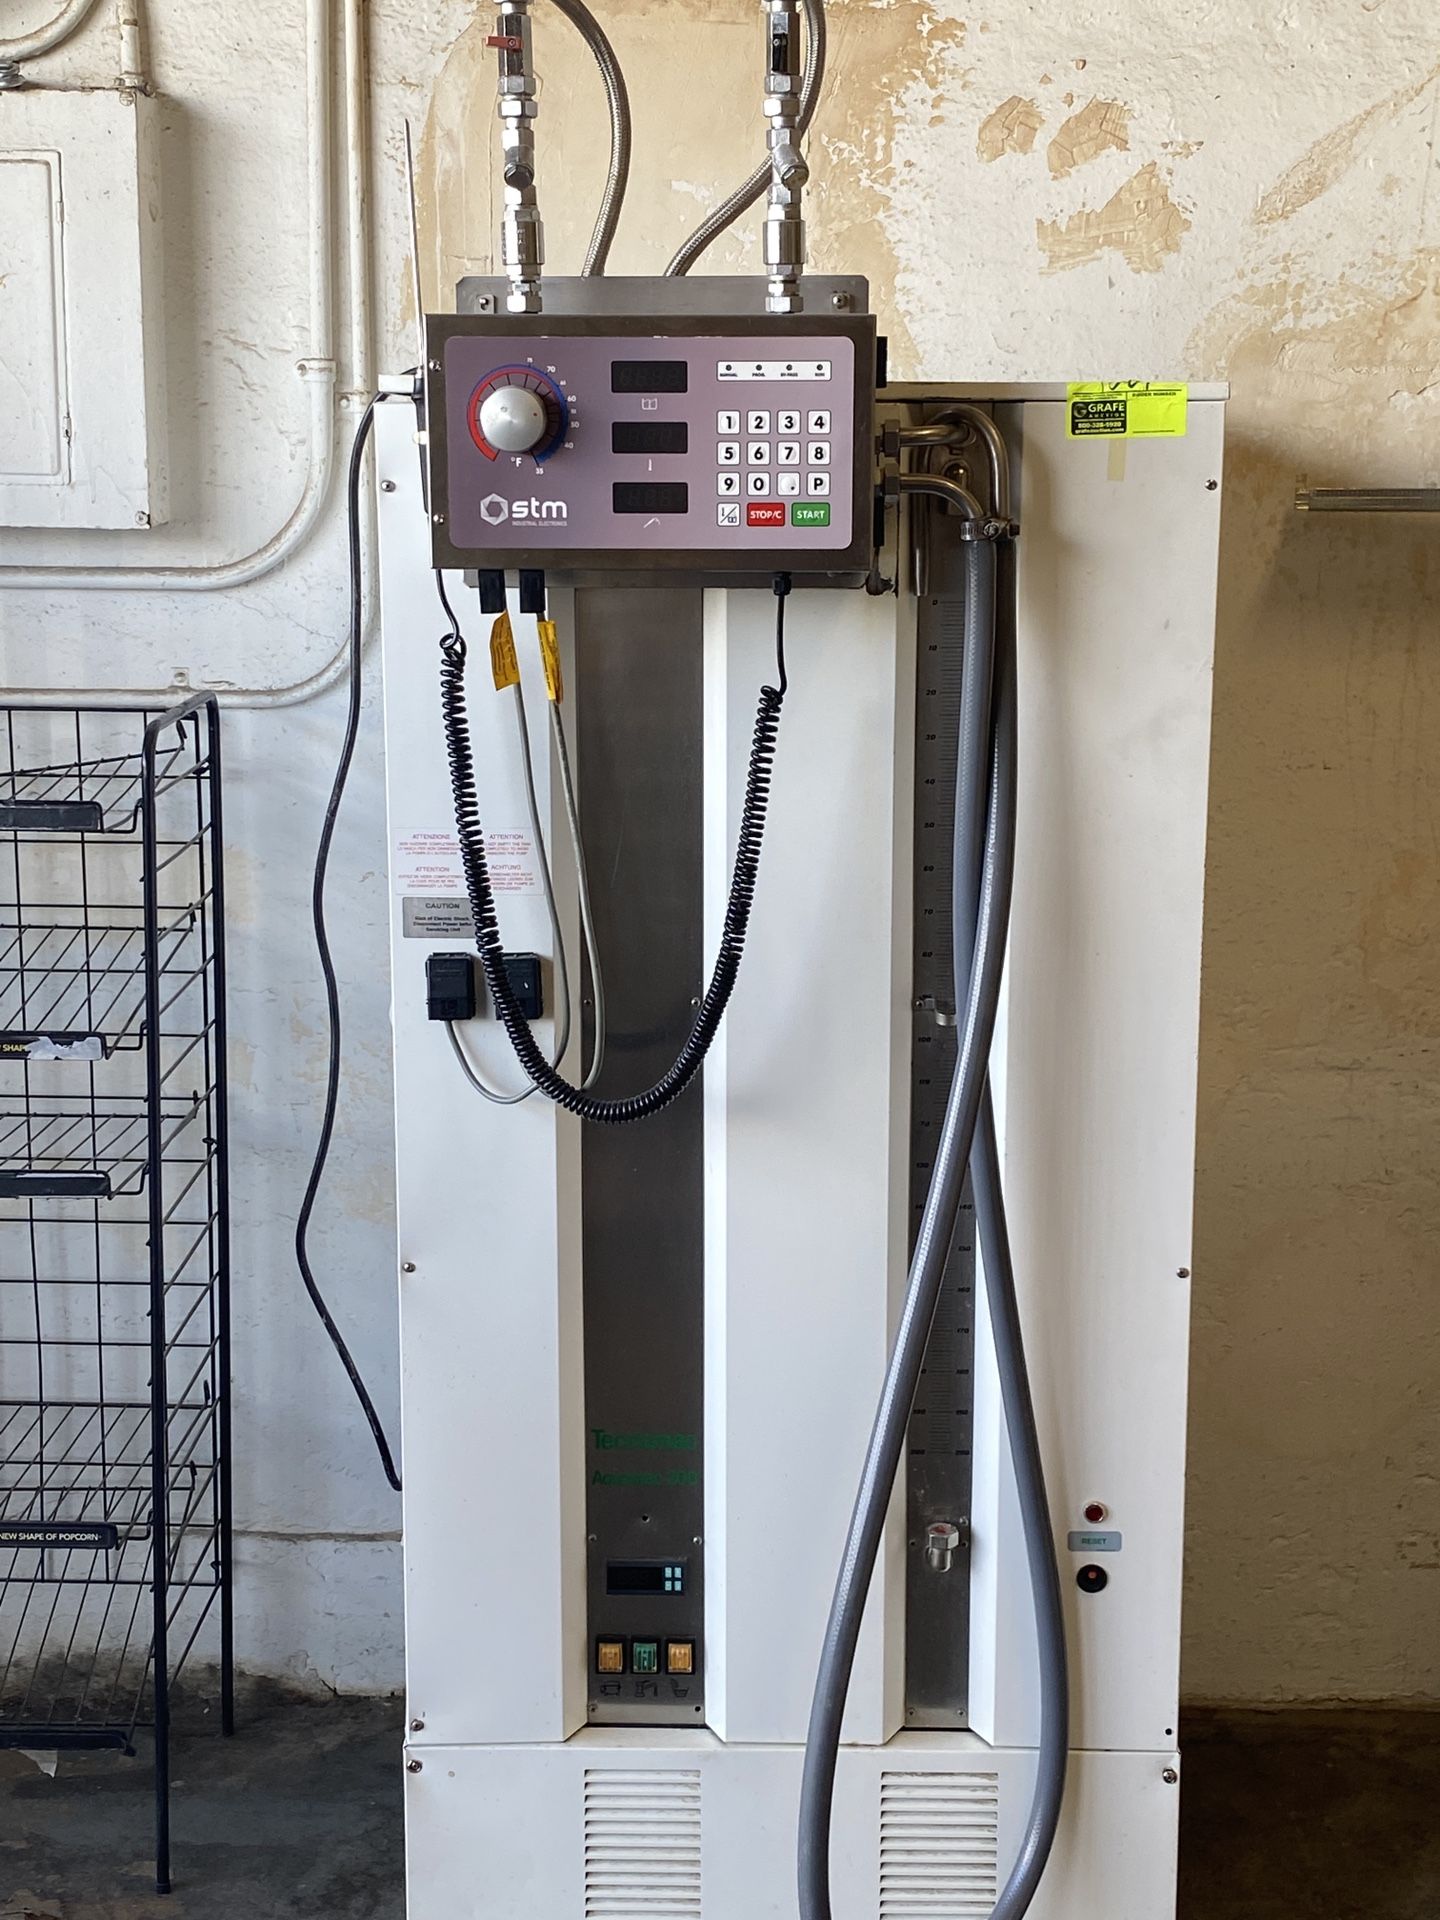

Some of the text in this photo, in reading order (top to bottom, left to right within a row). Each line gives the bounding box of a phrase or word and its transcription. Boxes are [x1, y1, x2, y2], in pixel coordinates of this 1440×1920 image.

[1088, 402, 1125, 412] GRAFE
[571, 421, 580, 429] 50
[726, 415, 732, 430] 1
[754, 415, 764, 429] 2
[784, 415, 794, 429] 3
[814, 415, 825, 429] 4
[724, 446, 734, 460] 5
[754, 446, 764, 460] 6
[784, 446, 794, 460] 7
[814, 446, 824, 460] 8
[535, 467, 544, 475] 35
[724, 477, 734, 491] 9
[753, 477, 764, 491] 0
[813, 477, 824, 491] P
[512, 497, 567, 518] stm
[750, 510, 782, 519] STOP/C
[797, 510, 825, 519] START
[18, 1533, 45, 1541] SHAPE
[45, 1533, 57, 1541] OF
